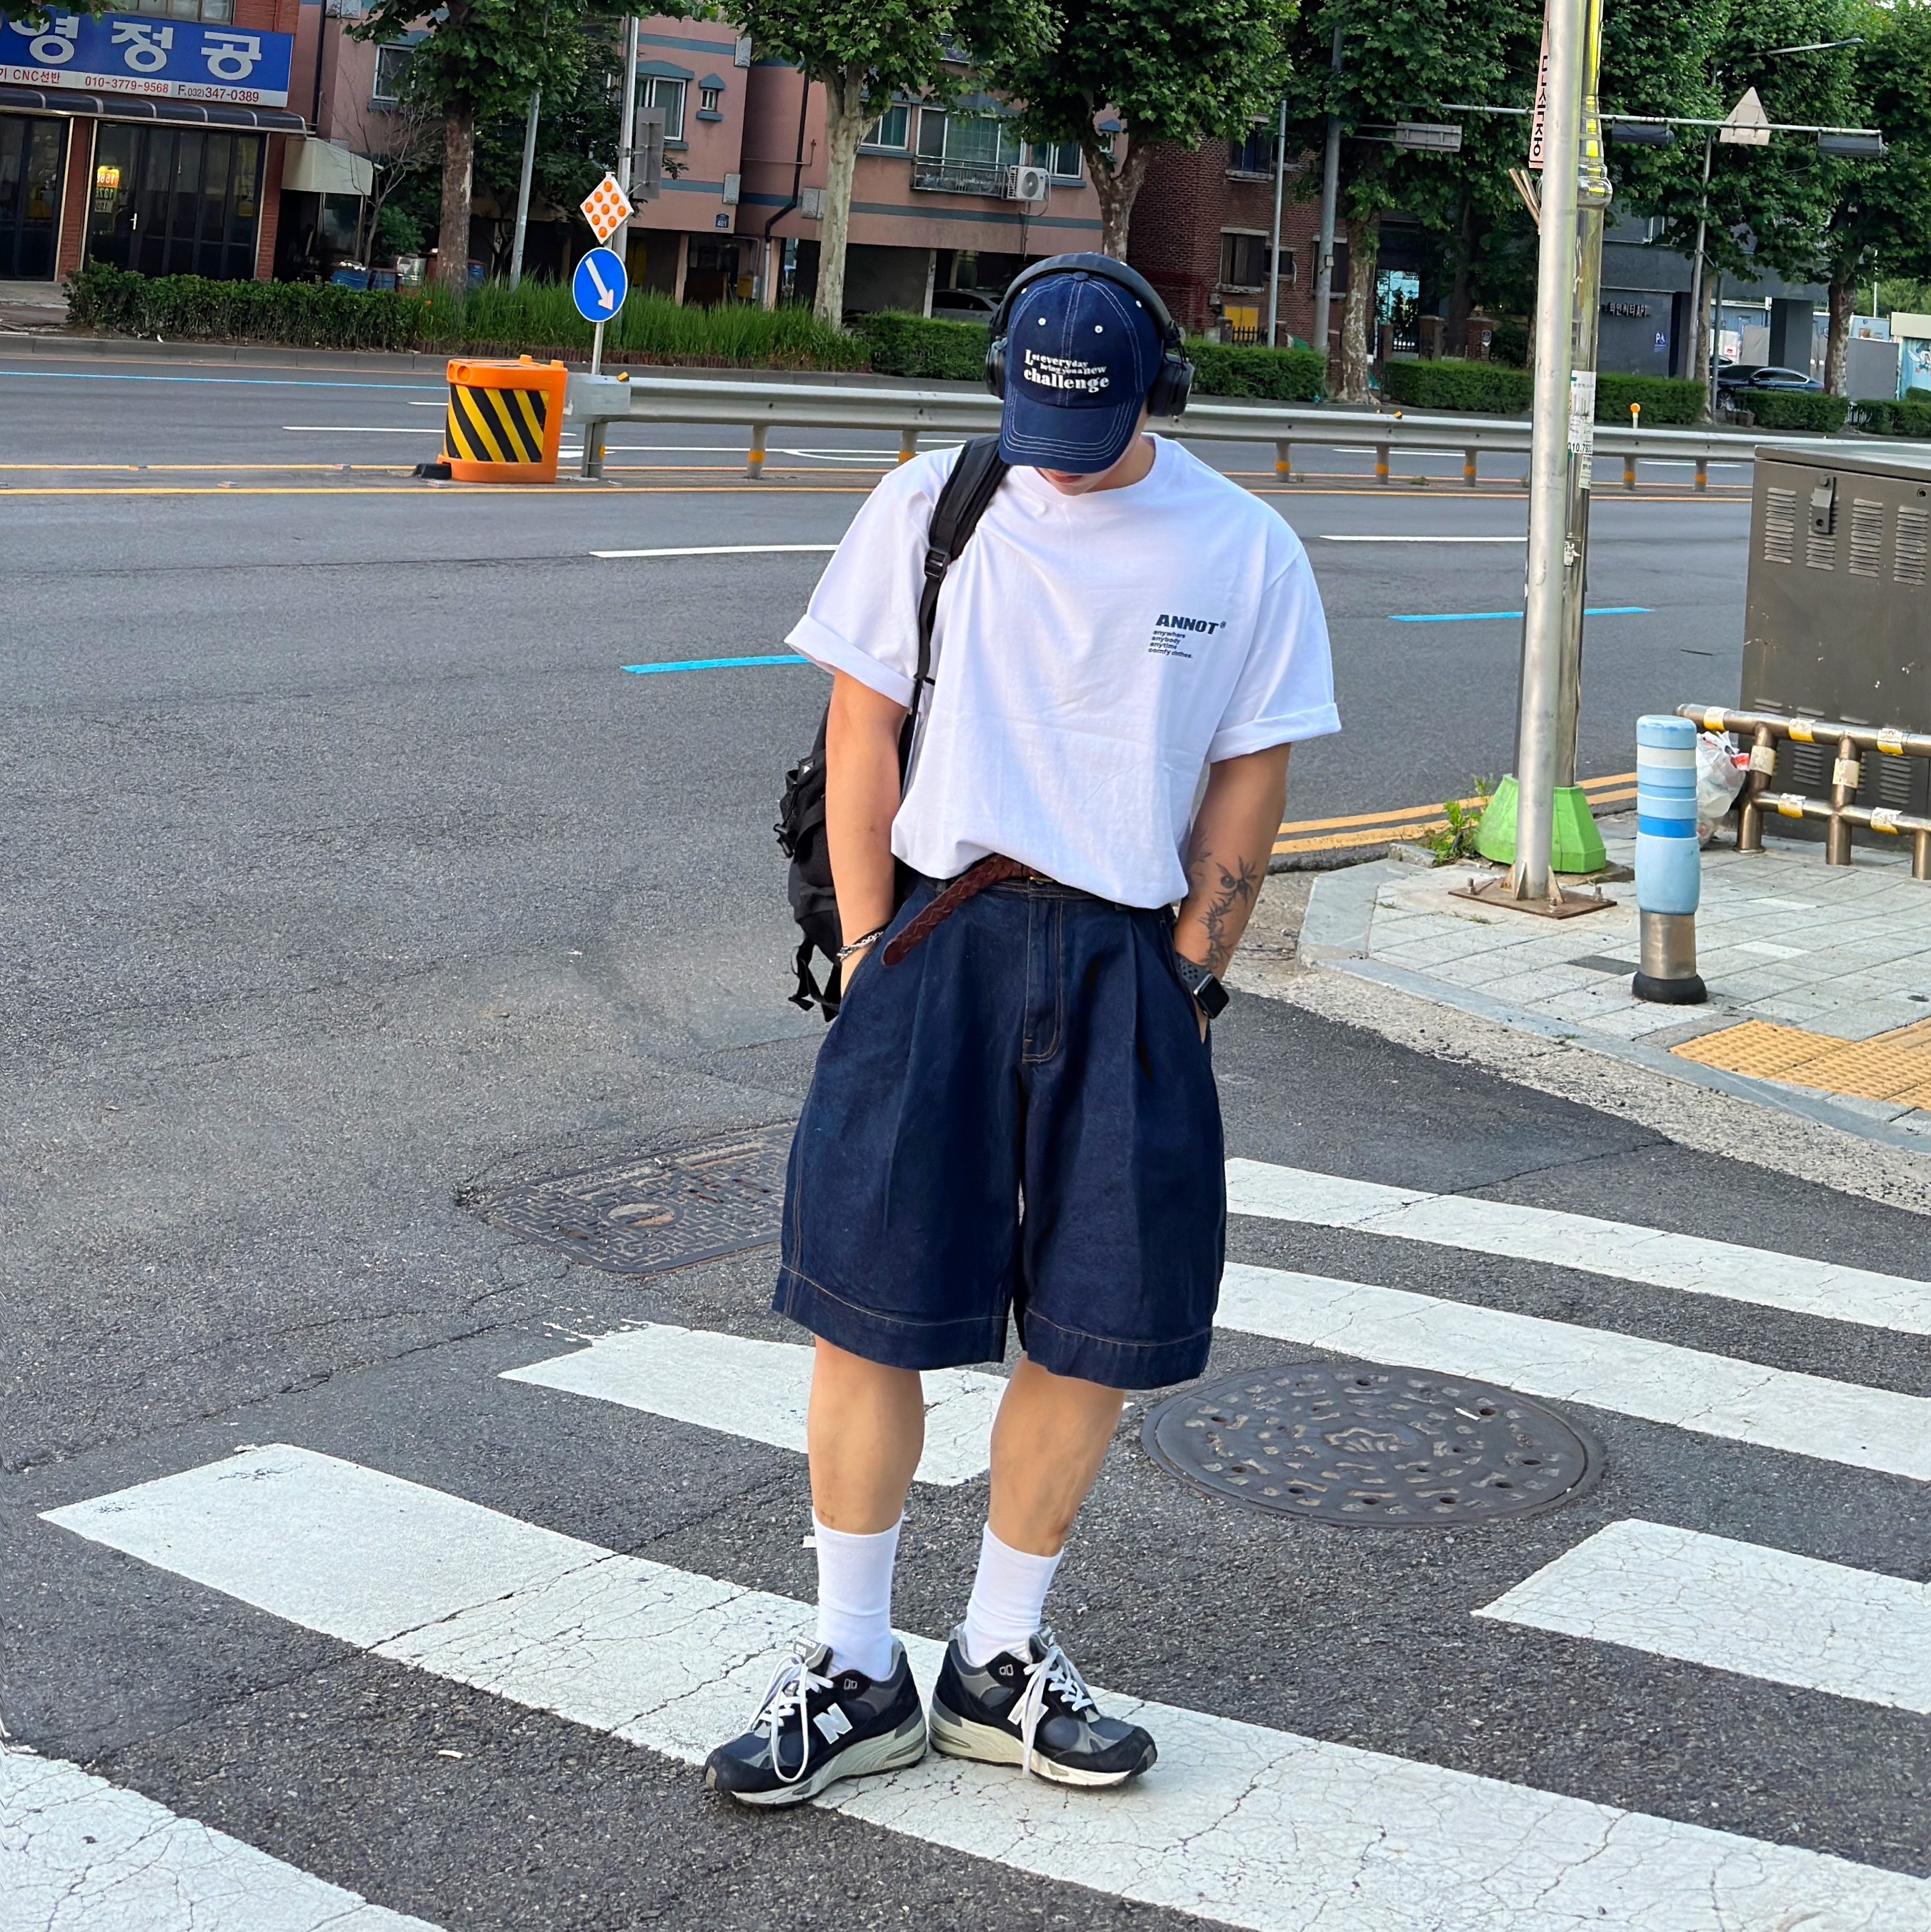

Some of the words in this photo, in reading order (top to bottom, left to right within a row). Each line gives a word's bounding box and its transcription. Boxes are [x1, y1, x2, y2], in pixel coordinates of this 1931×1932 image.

[0, 15, 261, 80] 영정공
[85, 76, 169, 93] 010-3779-9568
[1024, 349, 1039, 366] Let
[1040, 355, 1088, 369] everyday
[1040, 362, 1062, 374] bring
[1082, 366, 1107, 374] new
[1024, 368, 1109, 393] challenge
